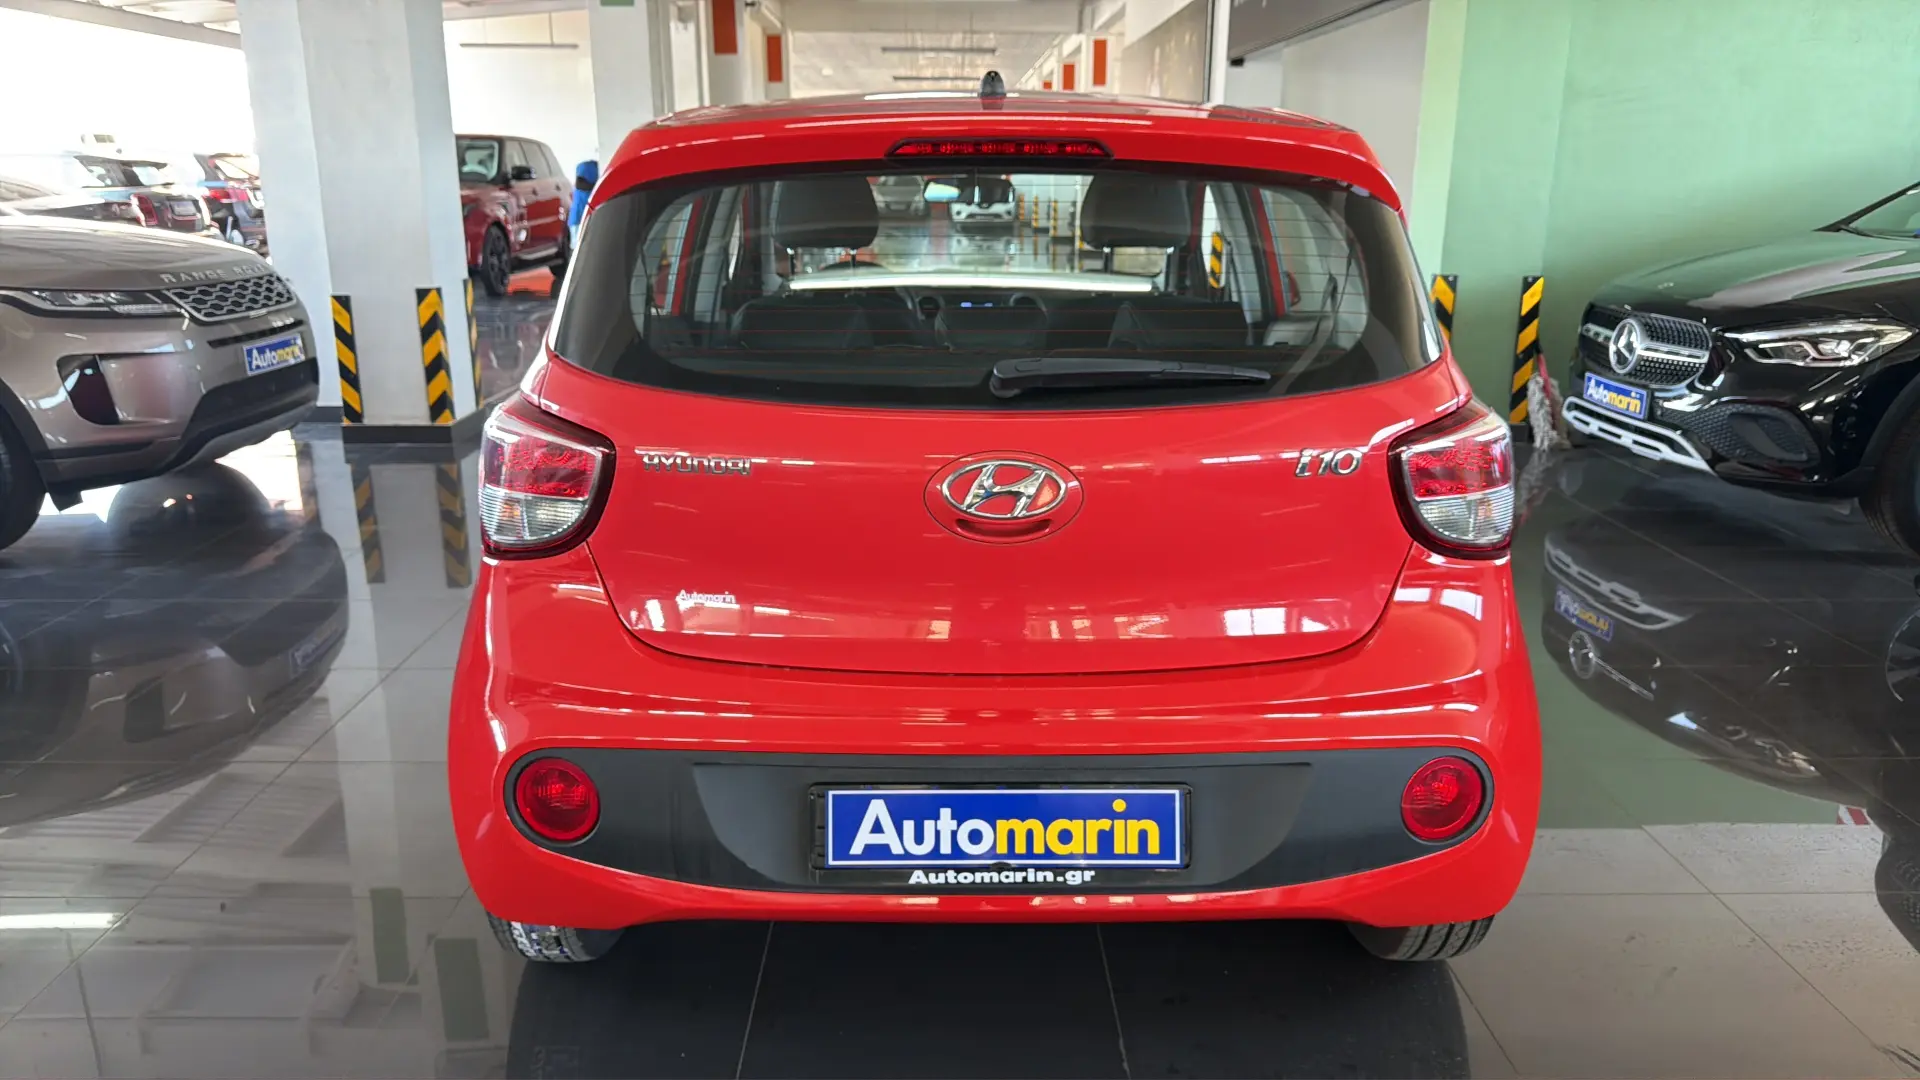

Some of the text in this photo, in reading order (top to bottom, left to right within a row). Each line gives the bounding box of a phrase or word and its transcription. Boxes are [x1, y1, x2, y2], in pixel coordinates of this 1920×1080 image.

[160, 270, 227, 284] RANGE
[1587, 379, 1641, 413] Automarin
[643, 453, 750, 475] HYUNDAI
[1295, 448, 1363, 477] i10
[678, 589, 736, 604] Automarin
[849, 799, 1160, 855] Automarin
[908, 869, 1096, 885] Automarin.gr
